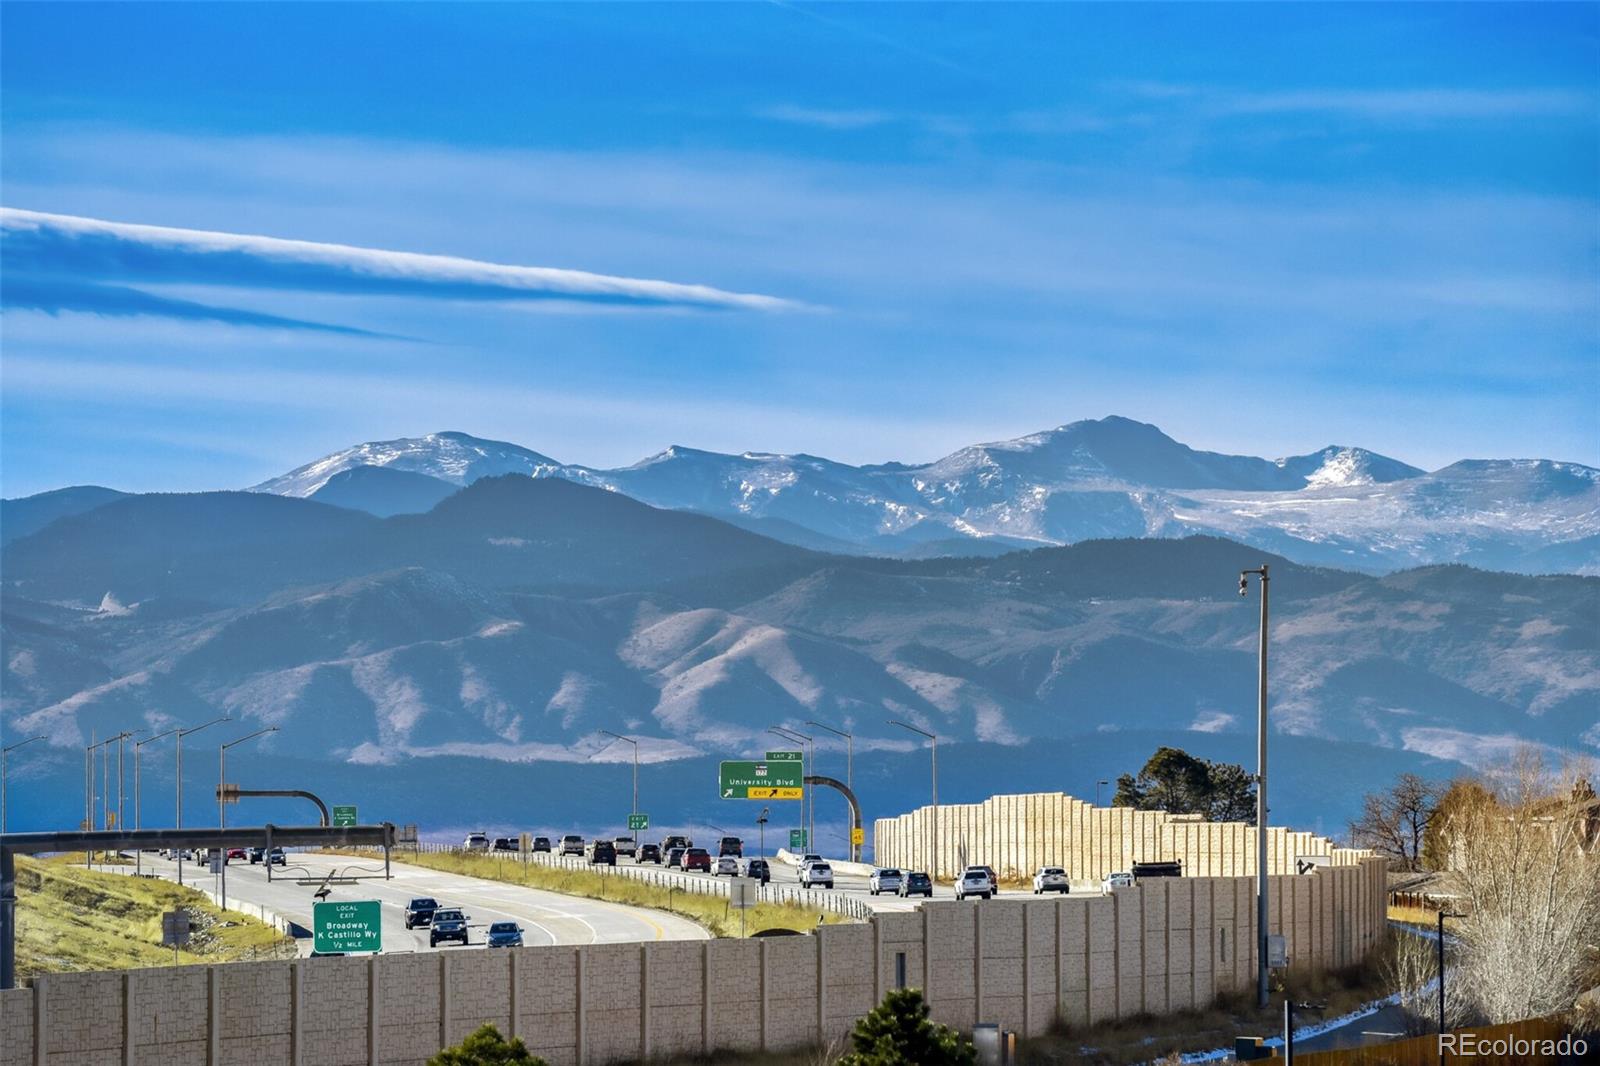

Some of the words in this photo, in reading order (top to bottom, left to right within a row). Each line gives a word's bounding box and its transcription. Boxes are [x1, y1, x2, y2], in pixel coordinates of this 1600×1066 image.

[326, 922, 369, 930] Broadway
[327, 931, 361, 939] Castillo
[364, 930, 377, 939] Wy
